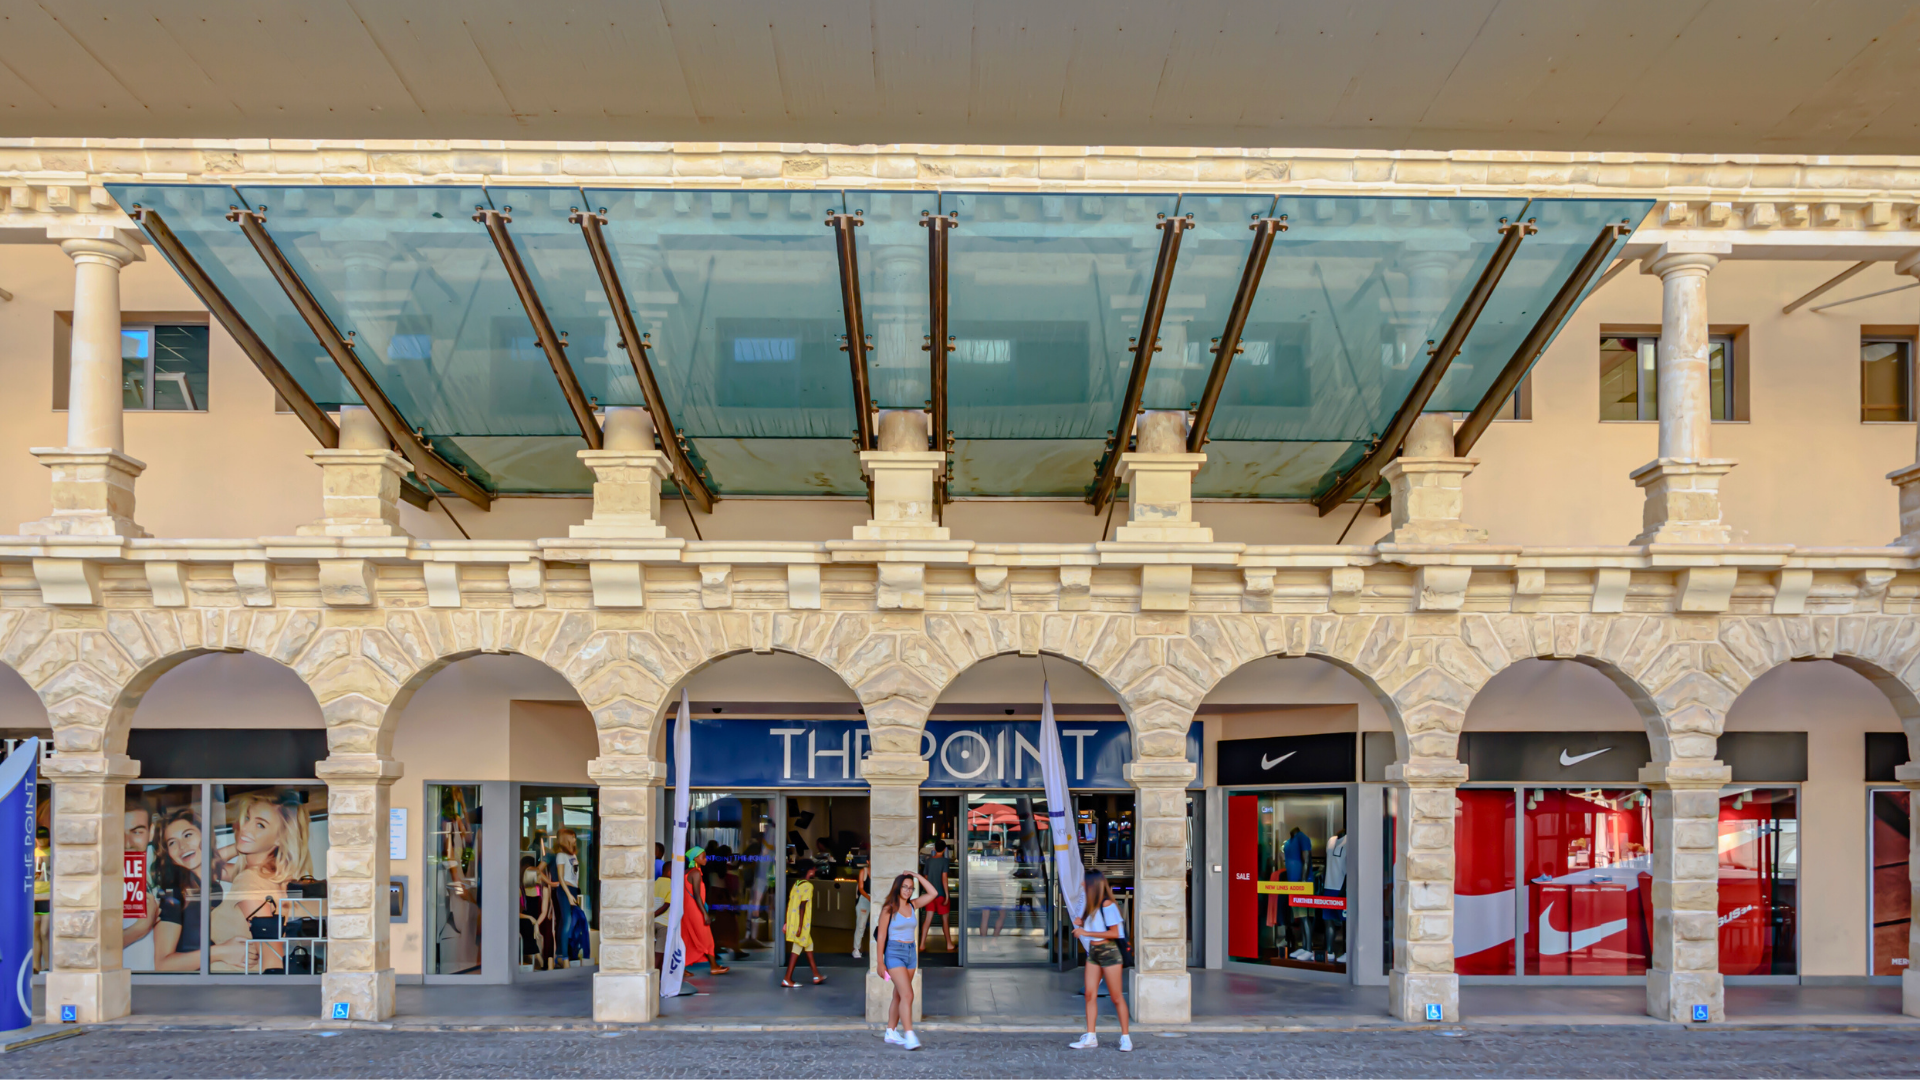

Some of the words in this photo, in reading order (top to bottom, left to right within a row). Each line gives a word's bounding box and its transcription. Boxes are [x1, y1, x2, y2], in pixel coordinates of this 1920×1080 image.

[25, 778, 34, 846] POINT
[24, 853, 33, 893] THE
[1314, 898, 1344, 906] REDUCTIONS
